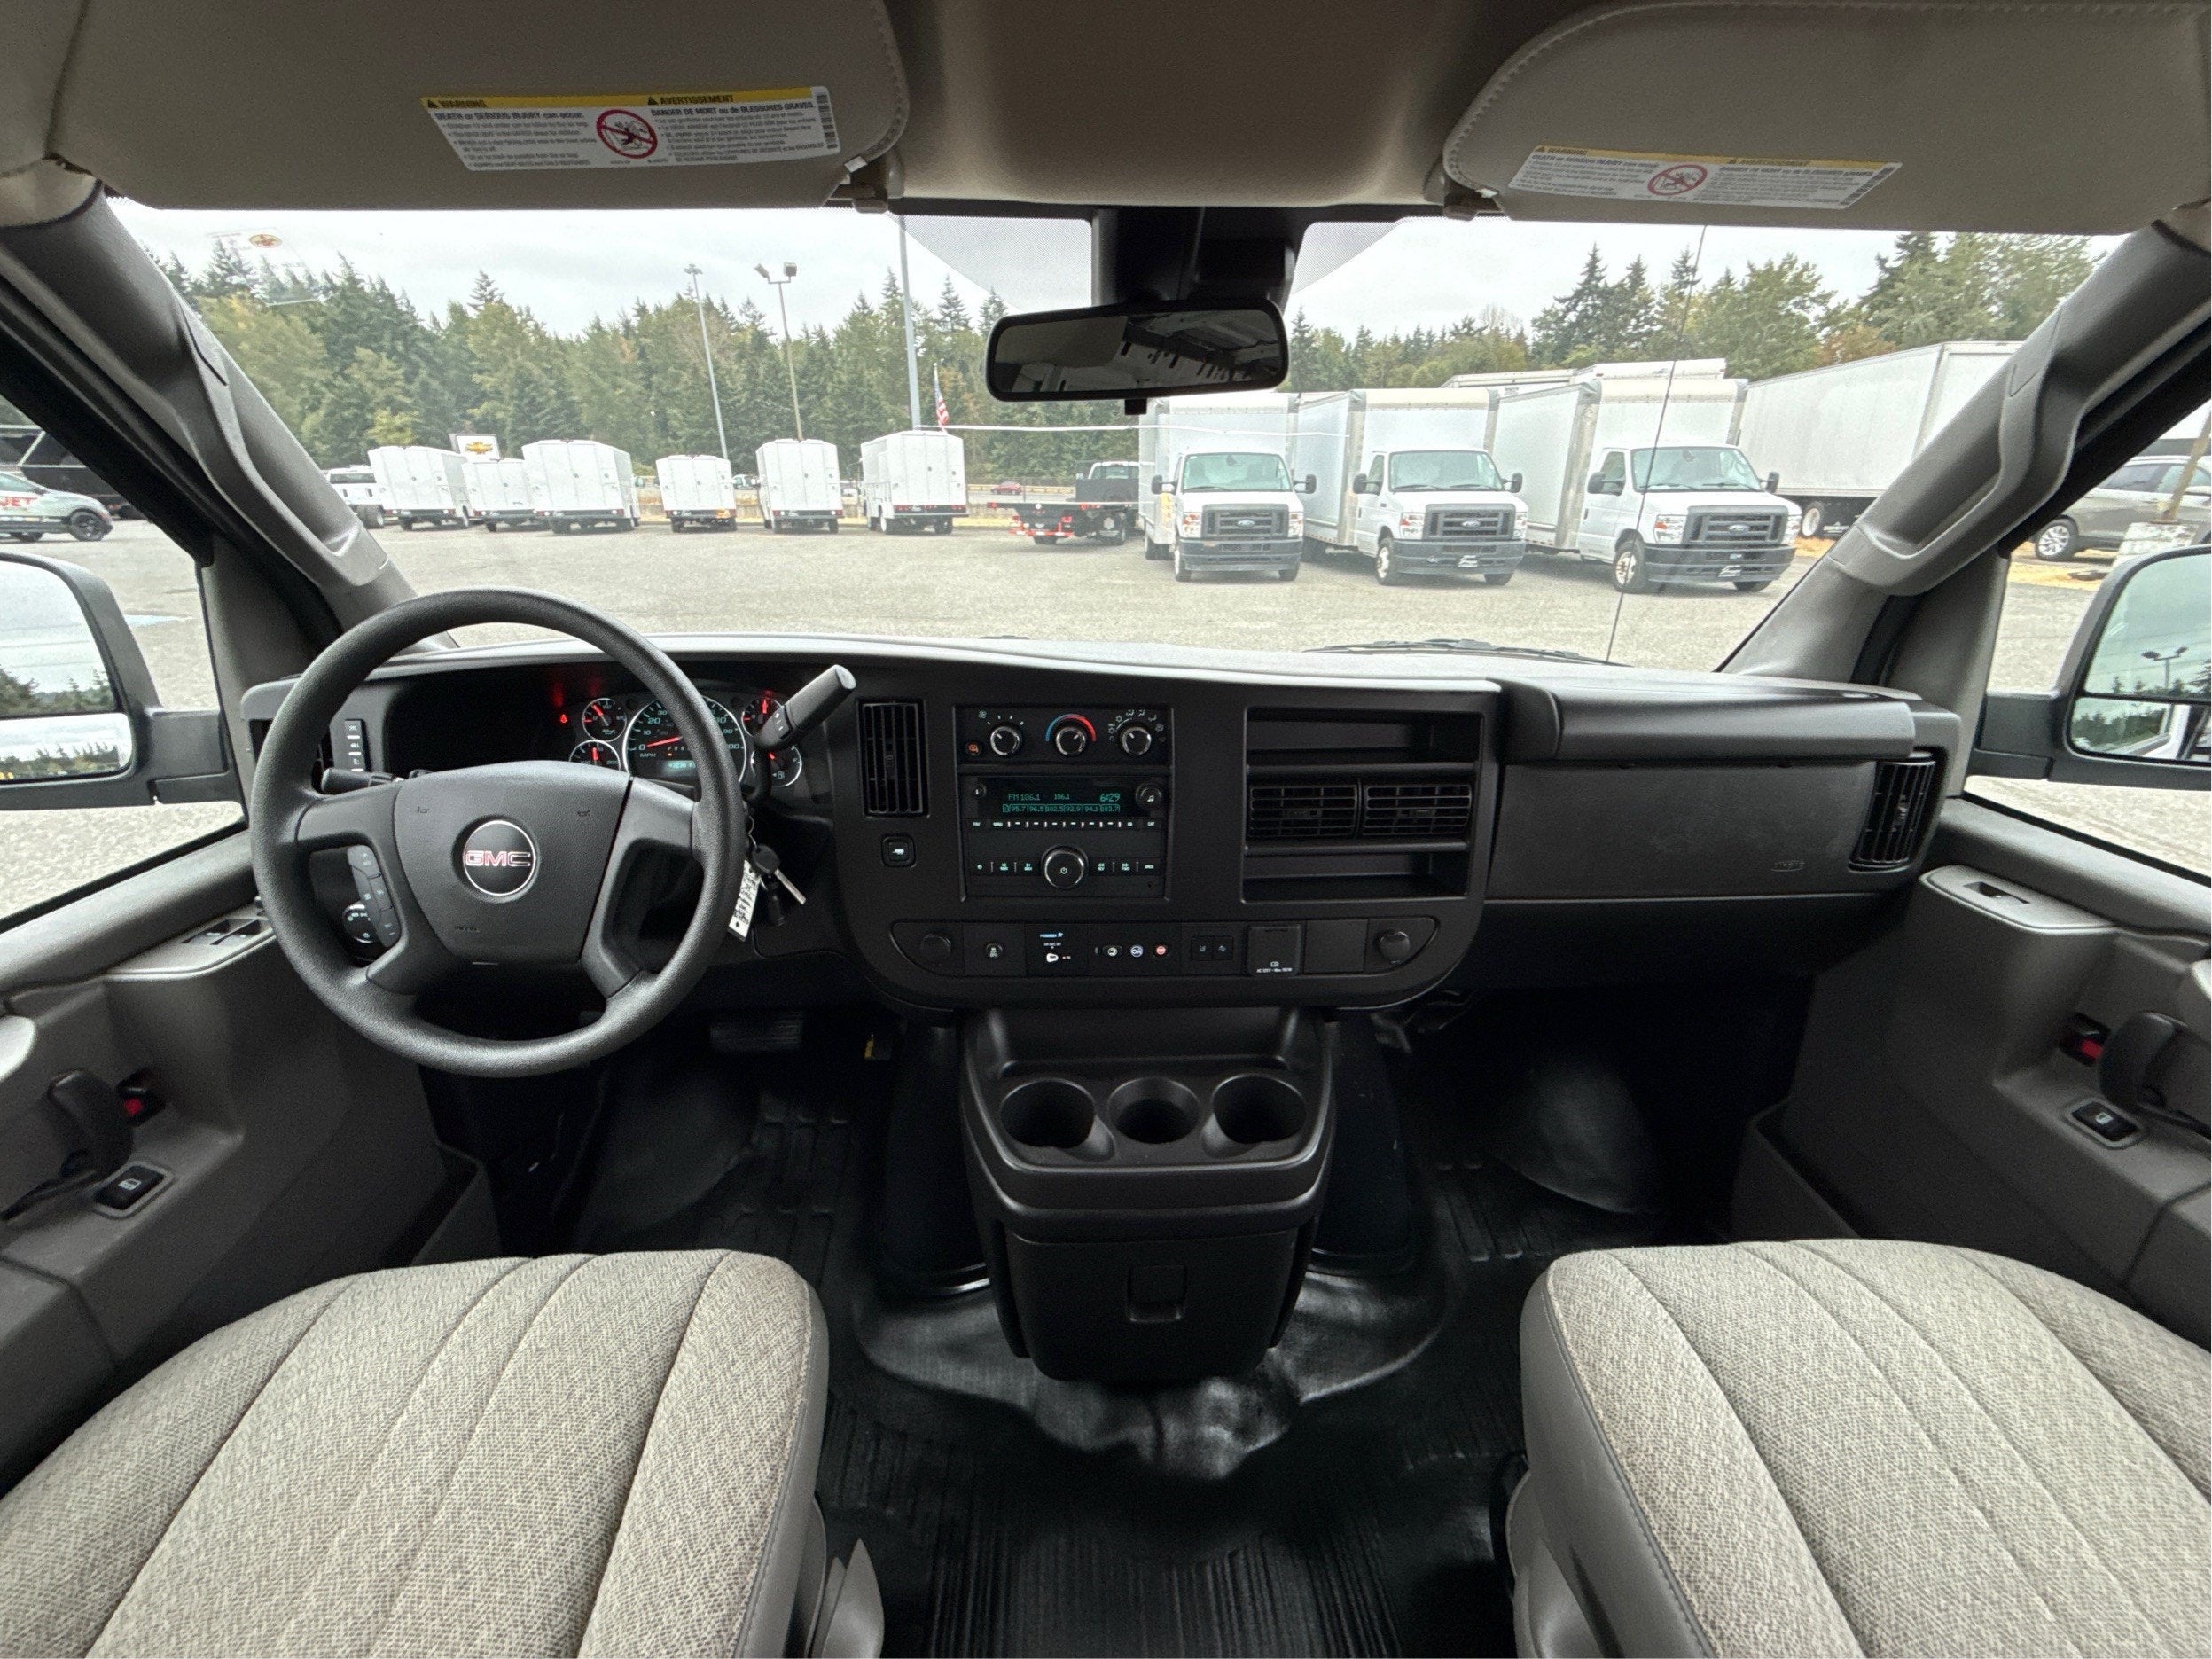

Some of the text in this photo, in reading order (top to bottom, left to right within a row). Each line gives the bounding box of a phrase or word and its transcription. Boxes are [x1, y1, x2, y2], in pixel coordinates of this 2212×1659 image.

[660, 95, 733, 105] AVERTISSEMENT
[740, 103, 783, 113] BLESSURES
[1099, 793, 1121, 802] 6:29
[465, 850, 531, 867] GMC
